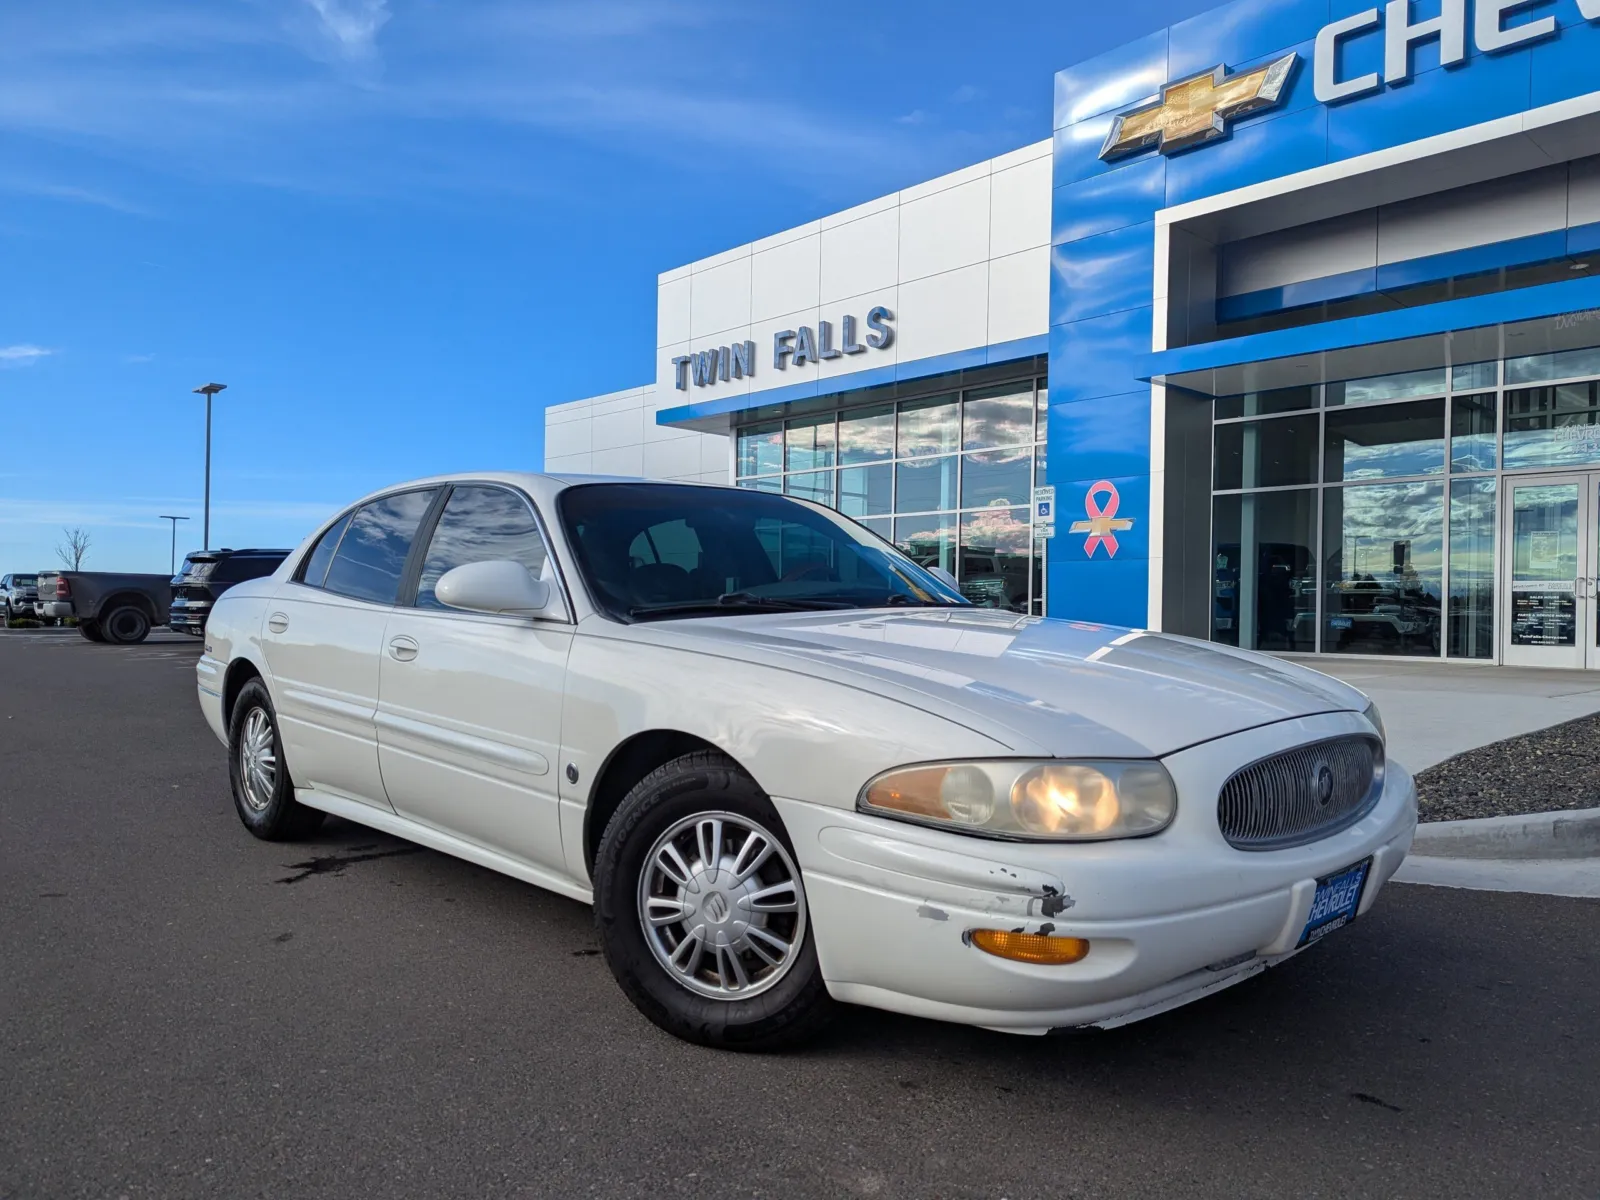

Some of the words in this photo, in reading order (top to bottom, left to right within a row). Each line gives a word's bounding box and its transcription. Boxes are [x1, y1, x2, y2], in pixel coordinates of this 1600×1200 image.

[1314, 0, 1600, 102] CHE
[672, 340, 755, 390] TWIN
[773, 306, 893, 371] FALLS
